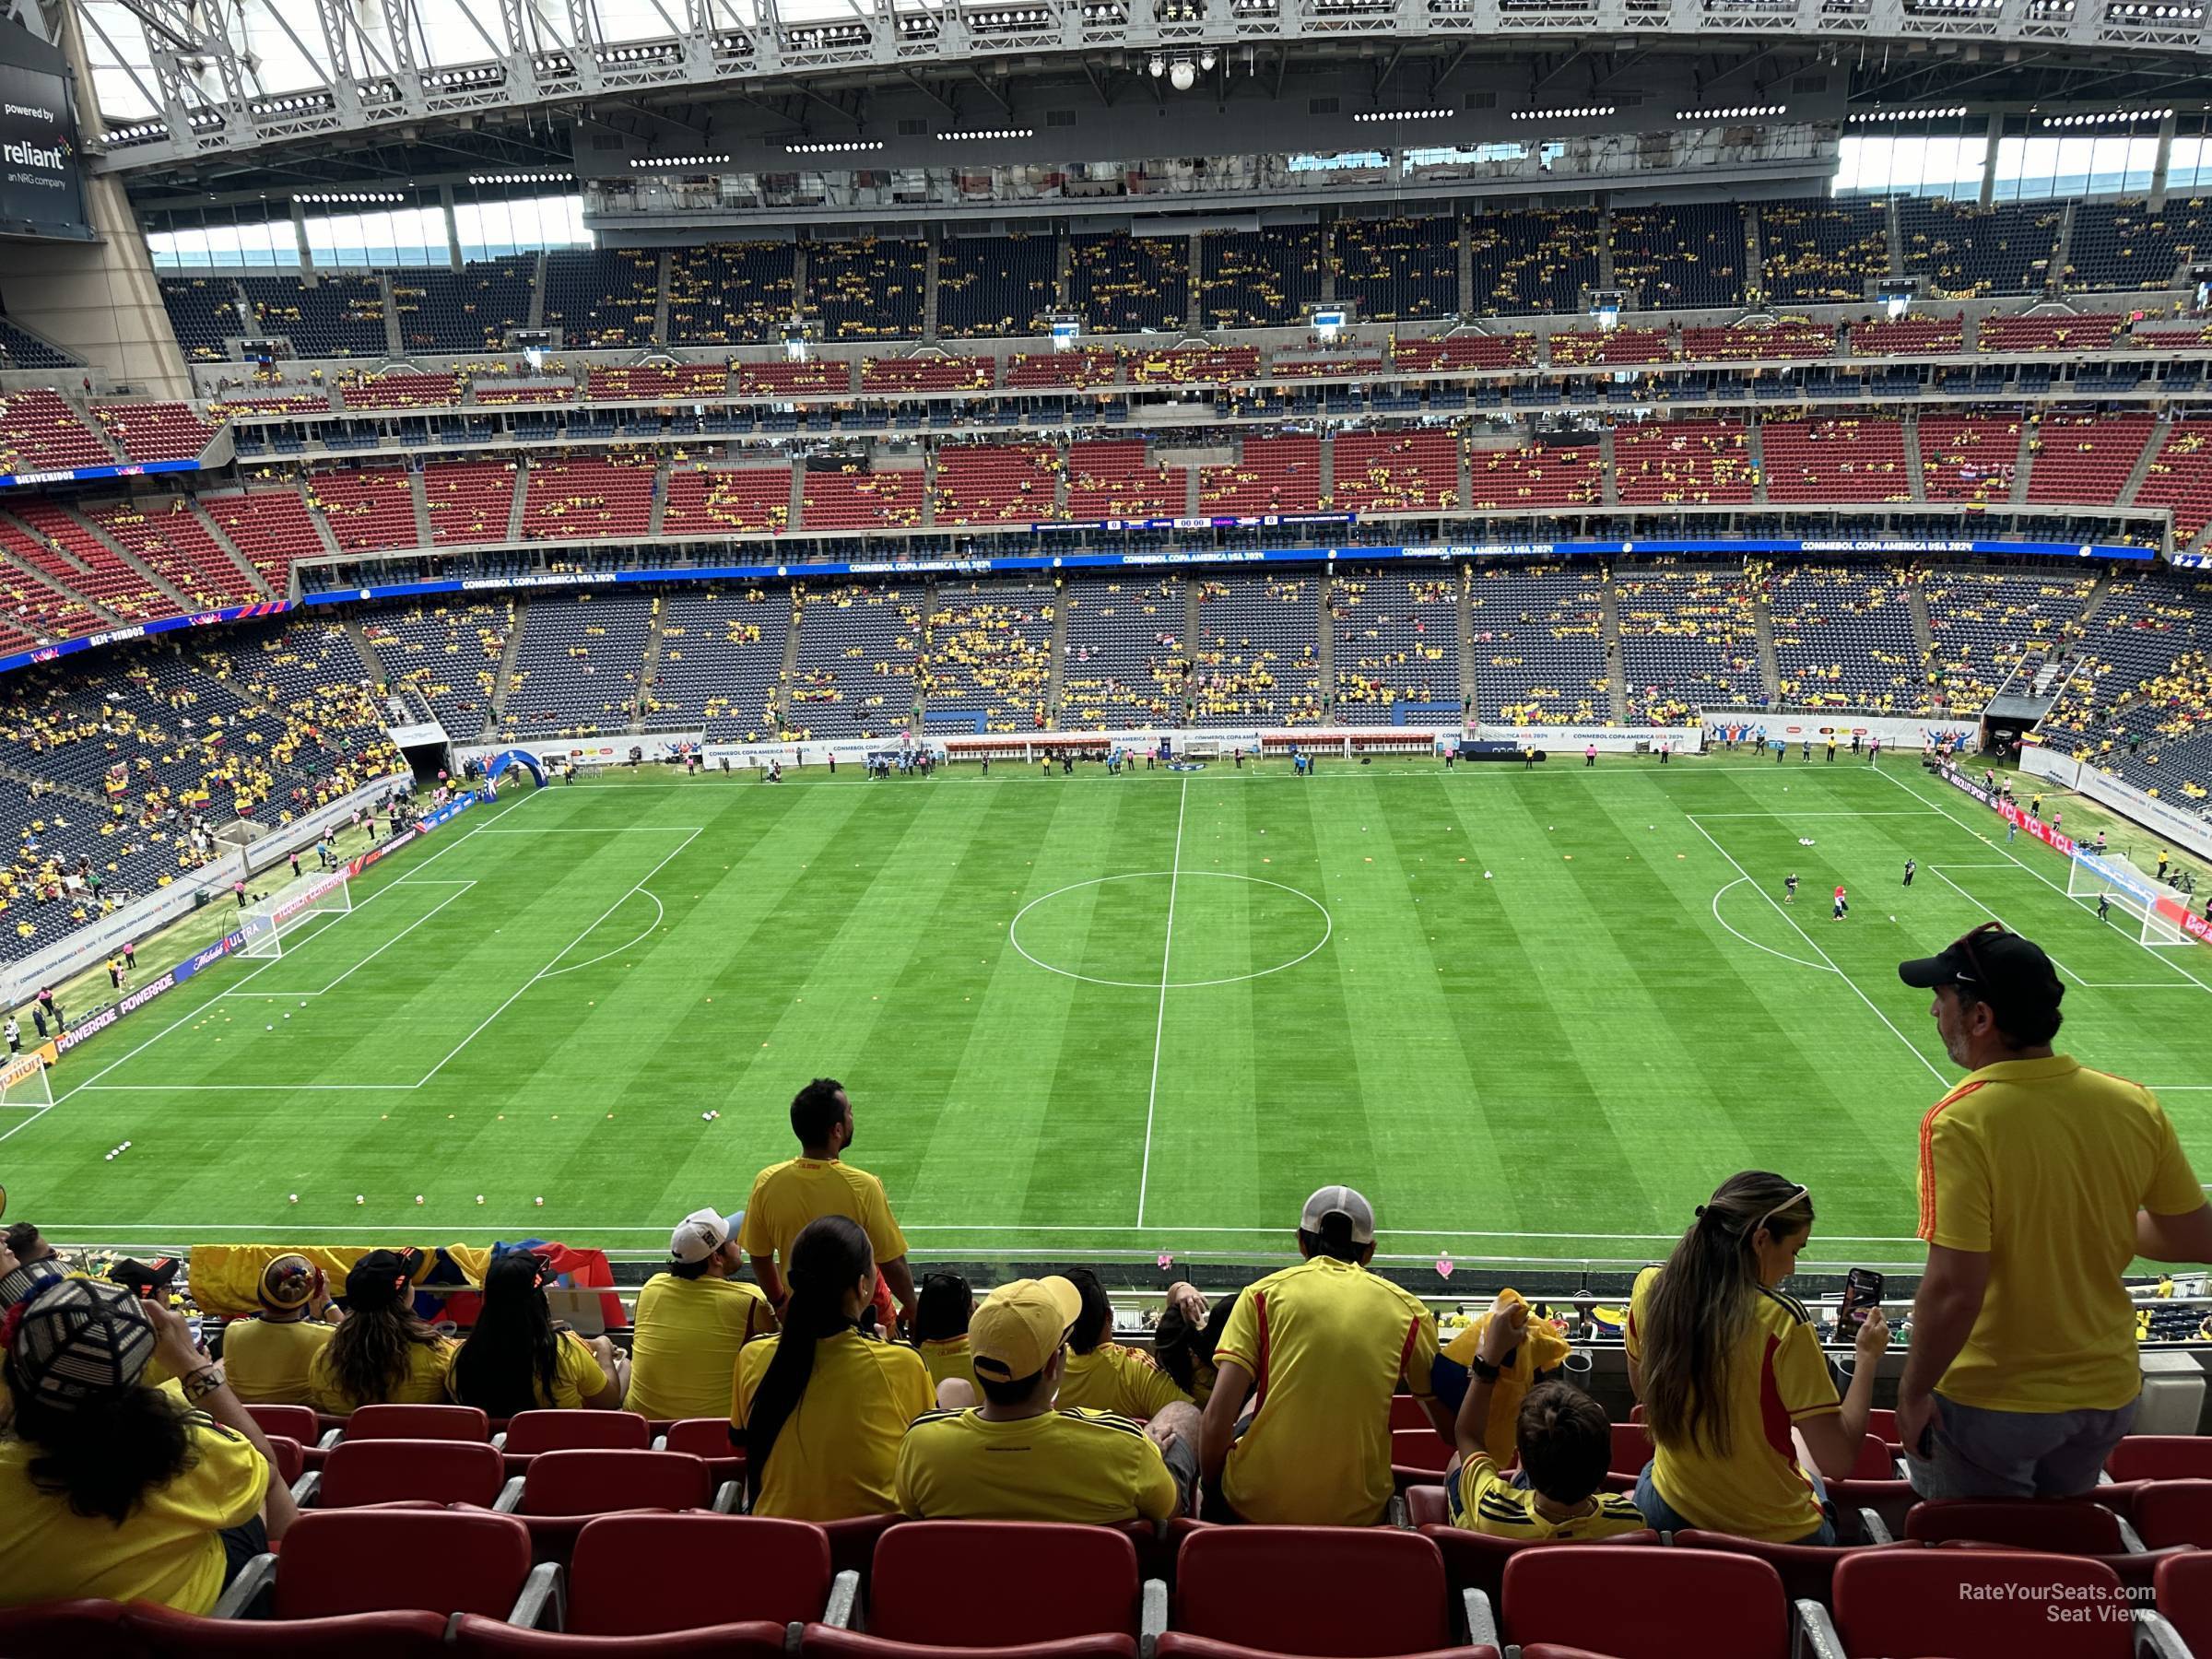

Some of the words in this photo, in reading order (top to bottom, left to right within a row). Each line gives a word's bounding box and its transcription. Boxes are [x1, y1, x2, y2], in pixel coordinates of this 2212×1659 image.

[4, 103, 43, 119] powered
[43, 110, 54, 124] by
[3, 140, 64, 170] reliant
[7, 173, 18, 182] an
[17, 172, 35, 185] NRG
[35, 177, 66, 191] company
[1402, 547, 1449, 555] CONMEBOL
[1450, 547, 1473, 555] COPA
[1801, 541, 1854, 550] CONMEBOL
[1855, 541, 1882, 550] COPA
[849, 564, 895, 572] CONMEBOL
[896, 563, 918, 571] COPA
[1123, 554, 1168, 563] CONMEBOL
[1169, 554, 1191, 562] COPA
[462, 578, 512, 589] CONMEBOL
[513, 577, 537, 587] COPA
[1999, 800, 2017, 821] TCL
[2023, 816, 2044, 839] TCL
[2049, 830, 2072, 854] TCL
[229, 923, 260, 947] ULTRA
[57, 1008, 118, 1053] POWERADE
[120, 974, 176, 1015] POWERADE
